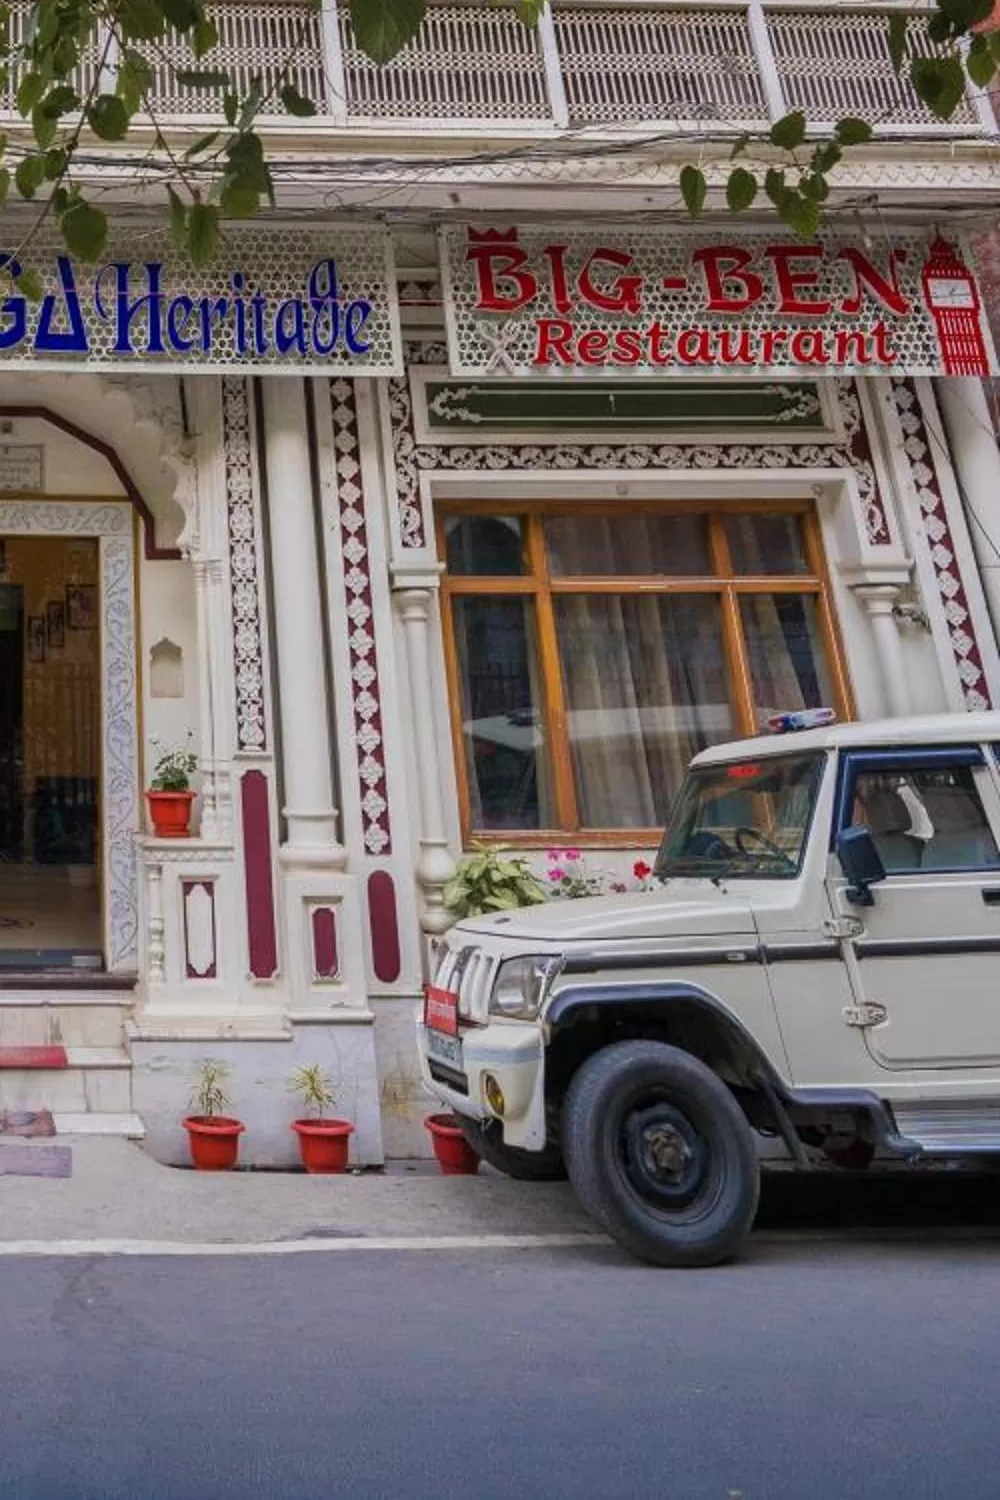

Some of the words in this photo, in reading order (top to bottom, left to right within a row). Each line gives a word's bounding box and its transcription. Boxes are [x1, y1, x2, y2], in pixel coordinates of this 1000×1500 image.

[95, 258, 373, 357] Heritage
[467, 245, 912, 316] BIG-BEN
[531, 318, 898, 368] Restaurant
